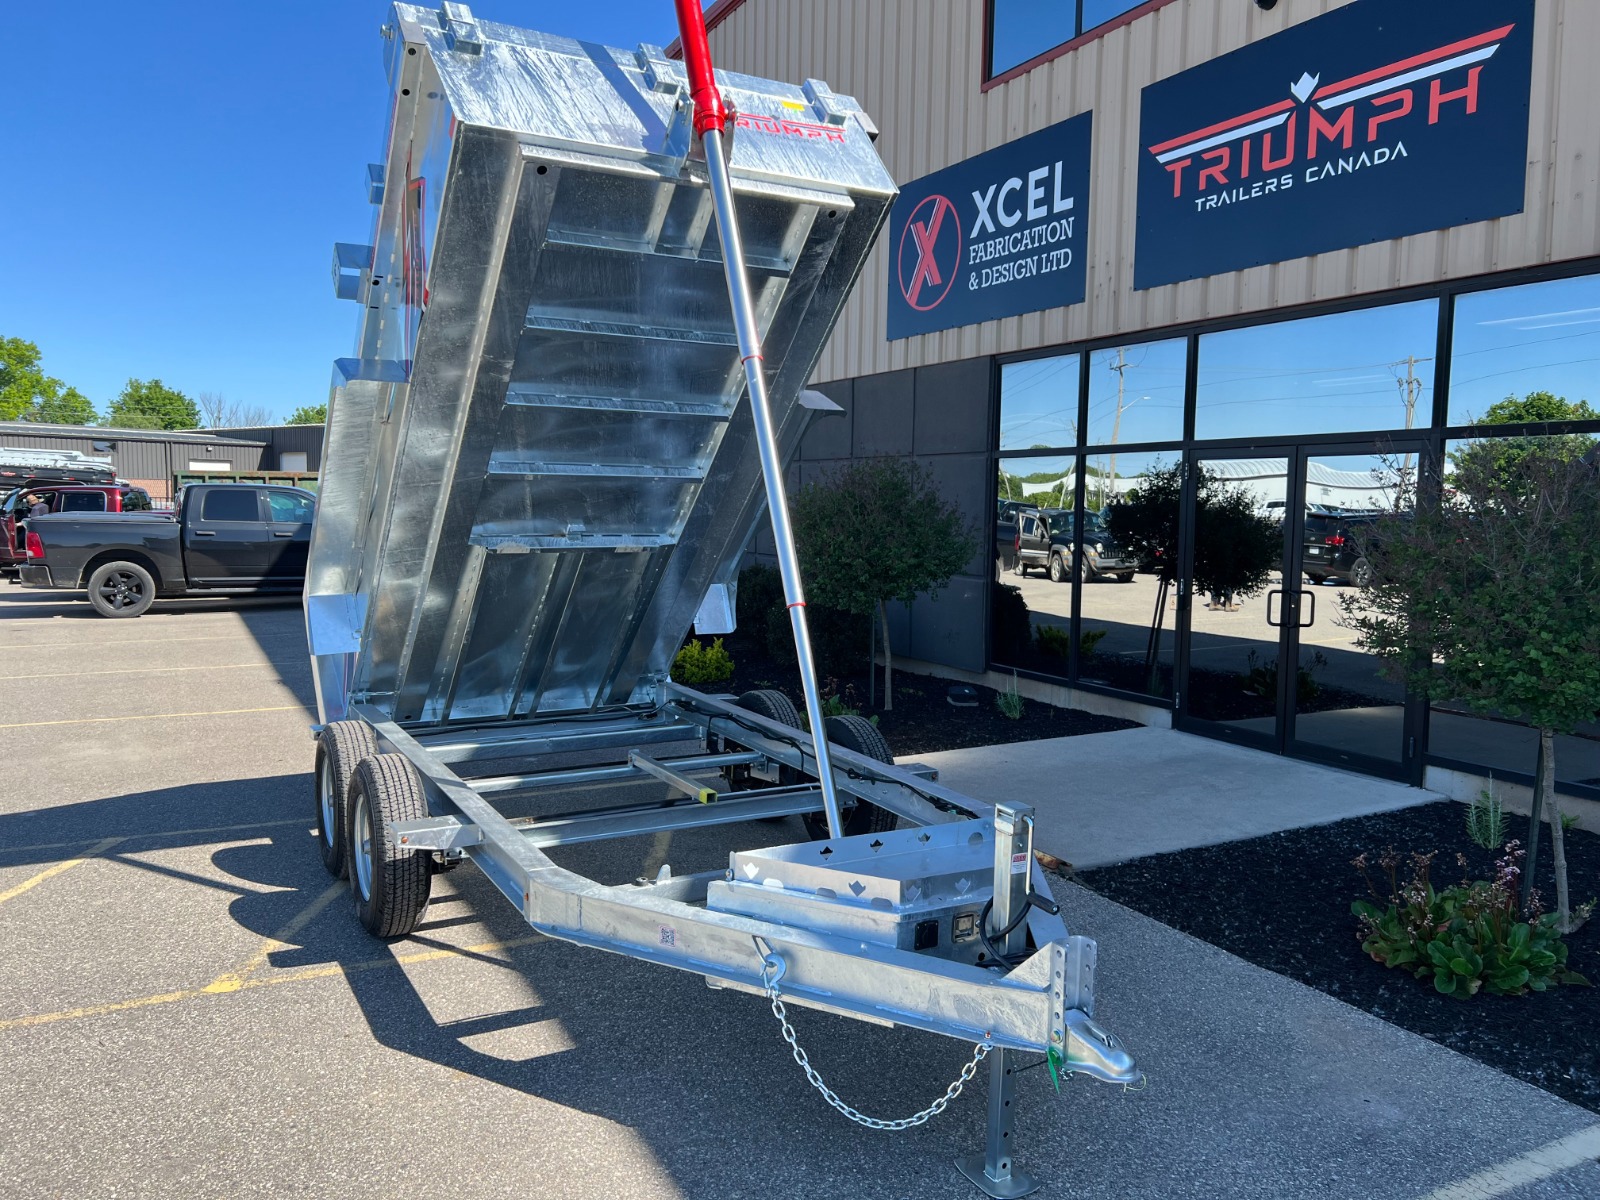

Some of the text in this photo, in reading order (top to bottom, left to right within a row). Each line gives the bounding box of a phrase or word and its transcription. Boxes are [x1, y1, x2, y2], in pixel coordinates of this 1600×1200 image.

[736, 119, 845, 143] RIUMPH
[1164, 65, 1484, 198] TRIUMPH
[970, 161, 1074, 239] XCEL
[1195, 141, 1408, 212] TRAILERS CANADA
[968, 217, 1074, 265] FABRICATION
[968, 248, 1072, 290] & DESIGN LTD
